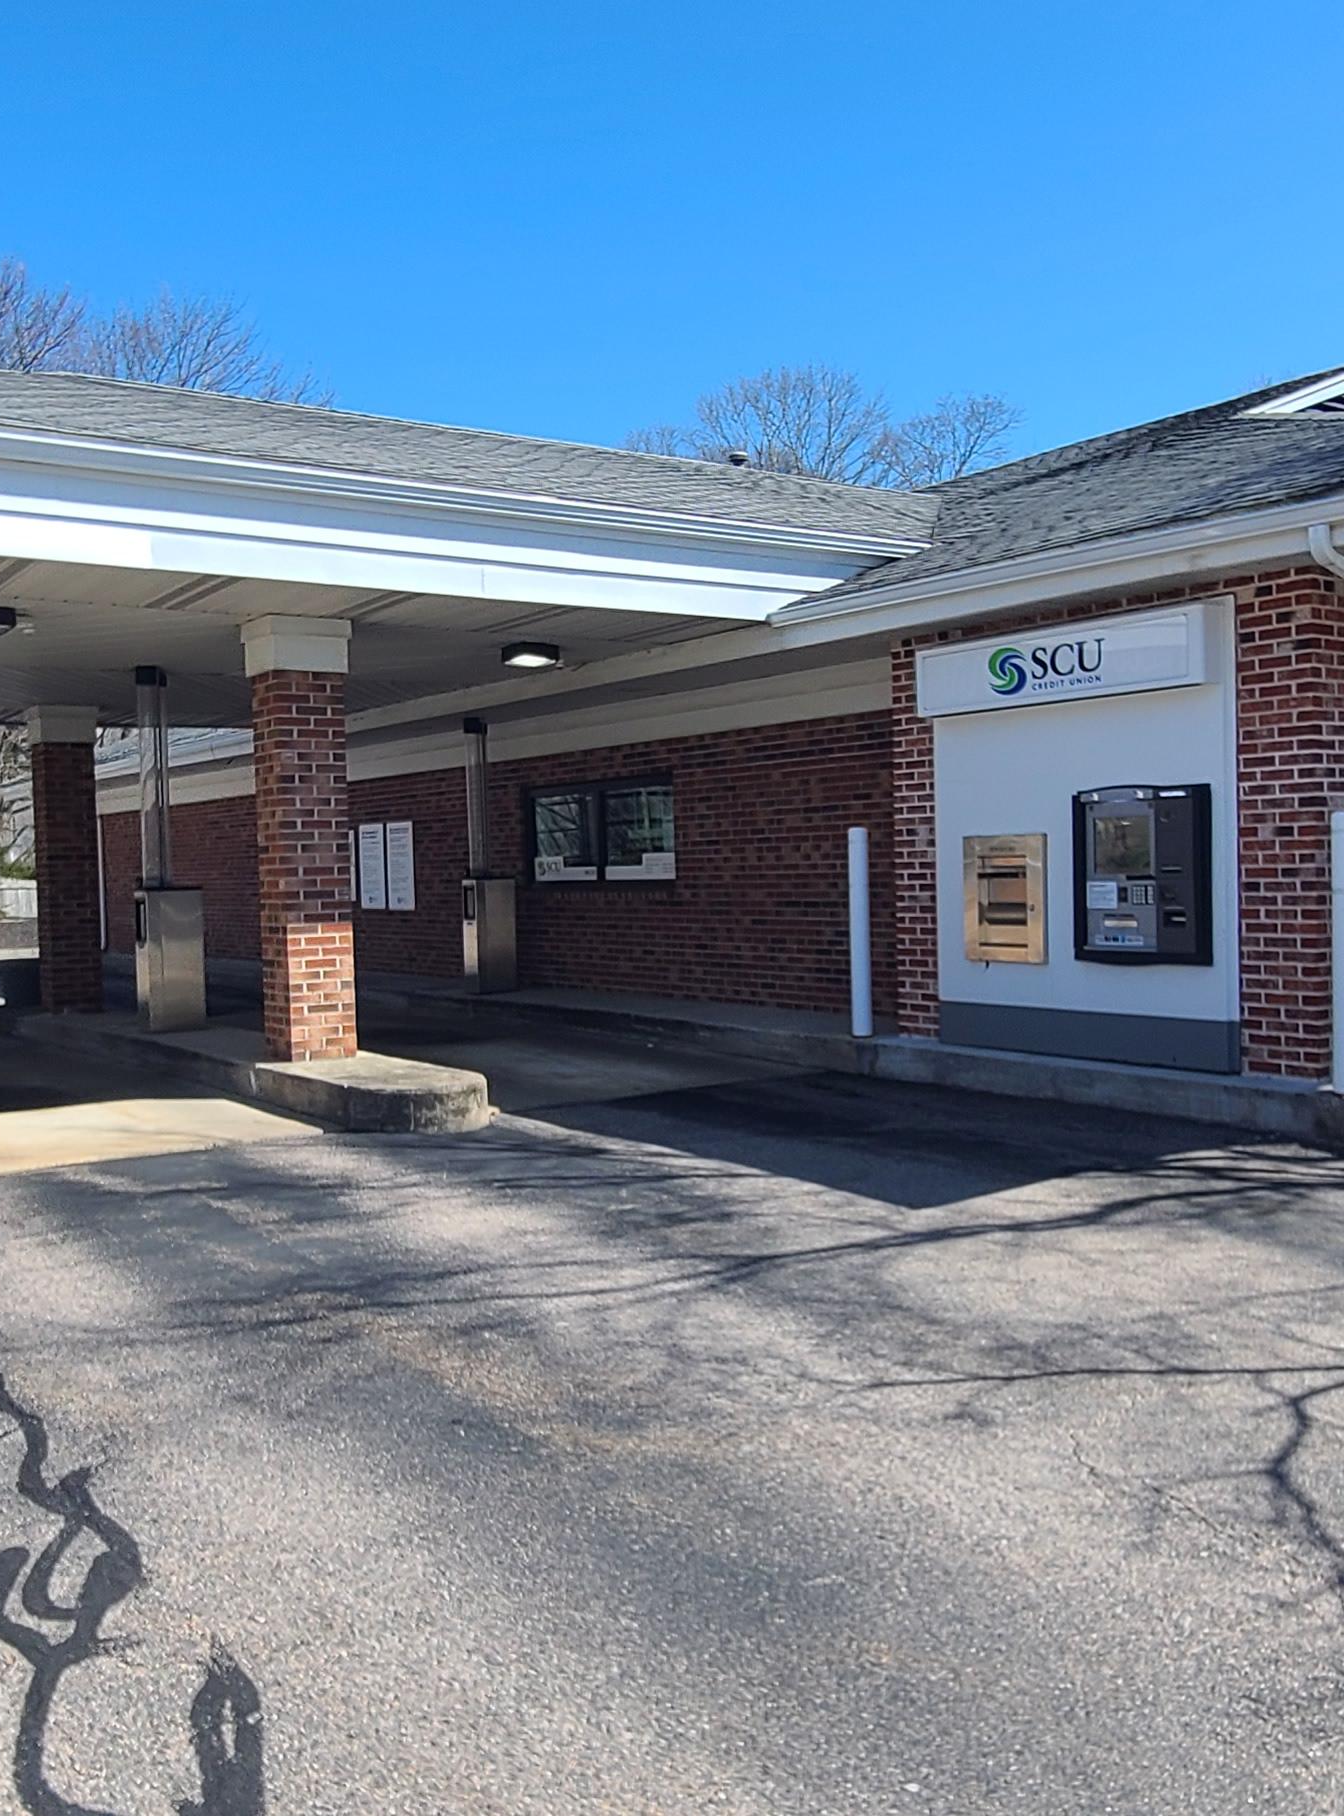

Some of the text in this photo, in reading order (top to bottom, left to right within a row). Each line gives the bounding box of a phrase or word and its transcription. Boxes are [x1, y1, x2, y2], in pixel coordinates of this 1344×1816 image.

[1031, 638, 1105, 679] SCU
[1032, 675, 1102, 691] CREDIT UNION
